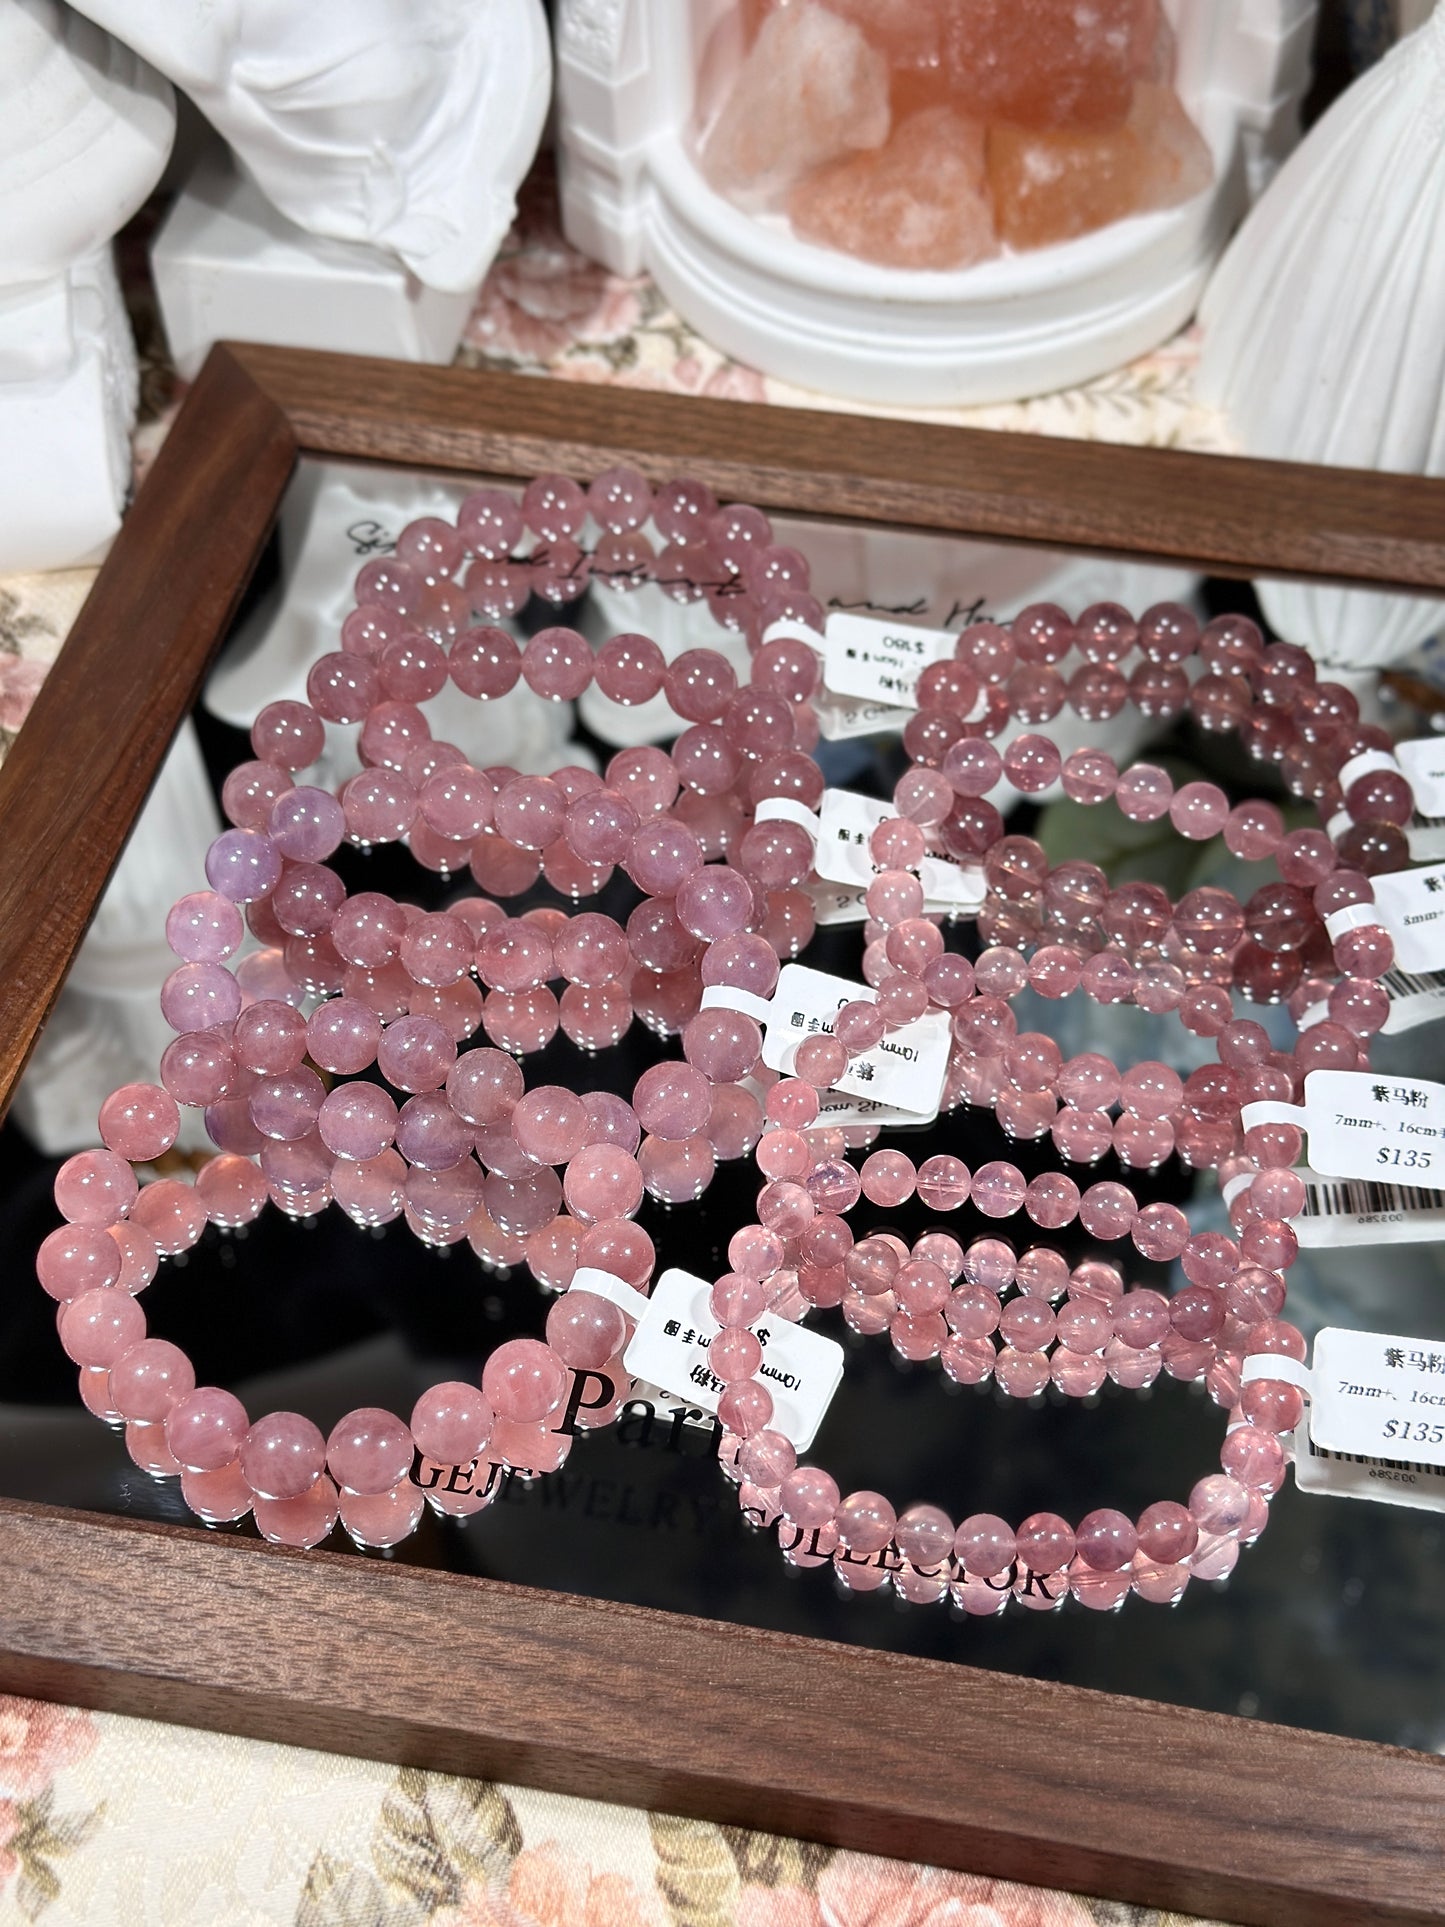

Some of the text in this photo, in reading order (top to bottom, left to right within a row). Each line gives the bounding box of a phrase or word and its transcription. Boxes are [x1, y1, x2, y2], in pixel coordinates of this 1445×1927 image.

[1371, 1084, 1429, 1109] 紫马粉
[1376, 1146, 1432, 1169] $135
[689, 1364, 729, 1394] 马粉
[550, 1367, 746, 1467] Pari
[1383, 1418, 1444, 1444] $135
[740, 1506, 1056, 1601] COLEOR
